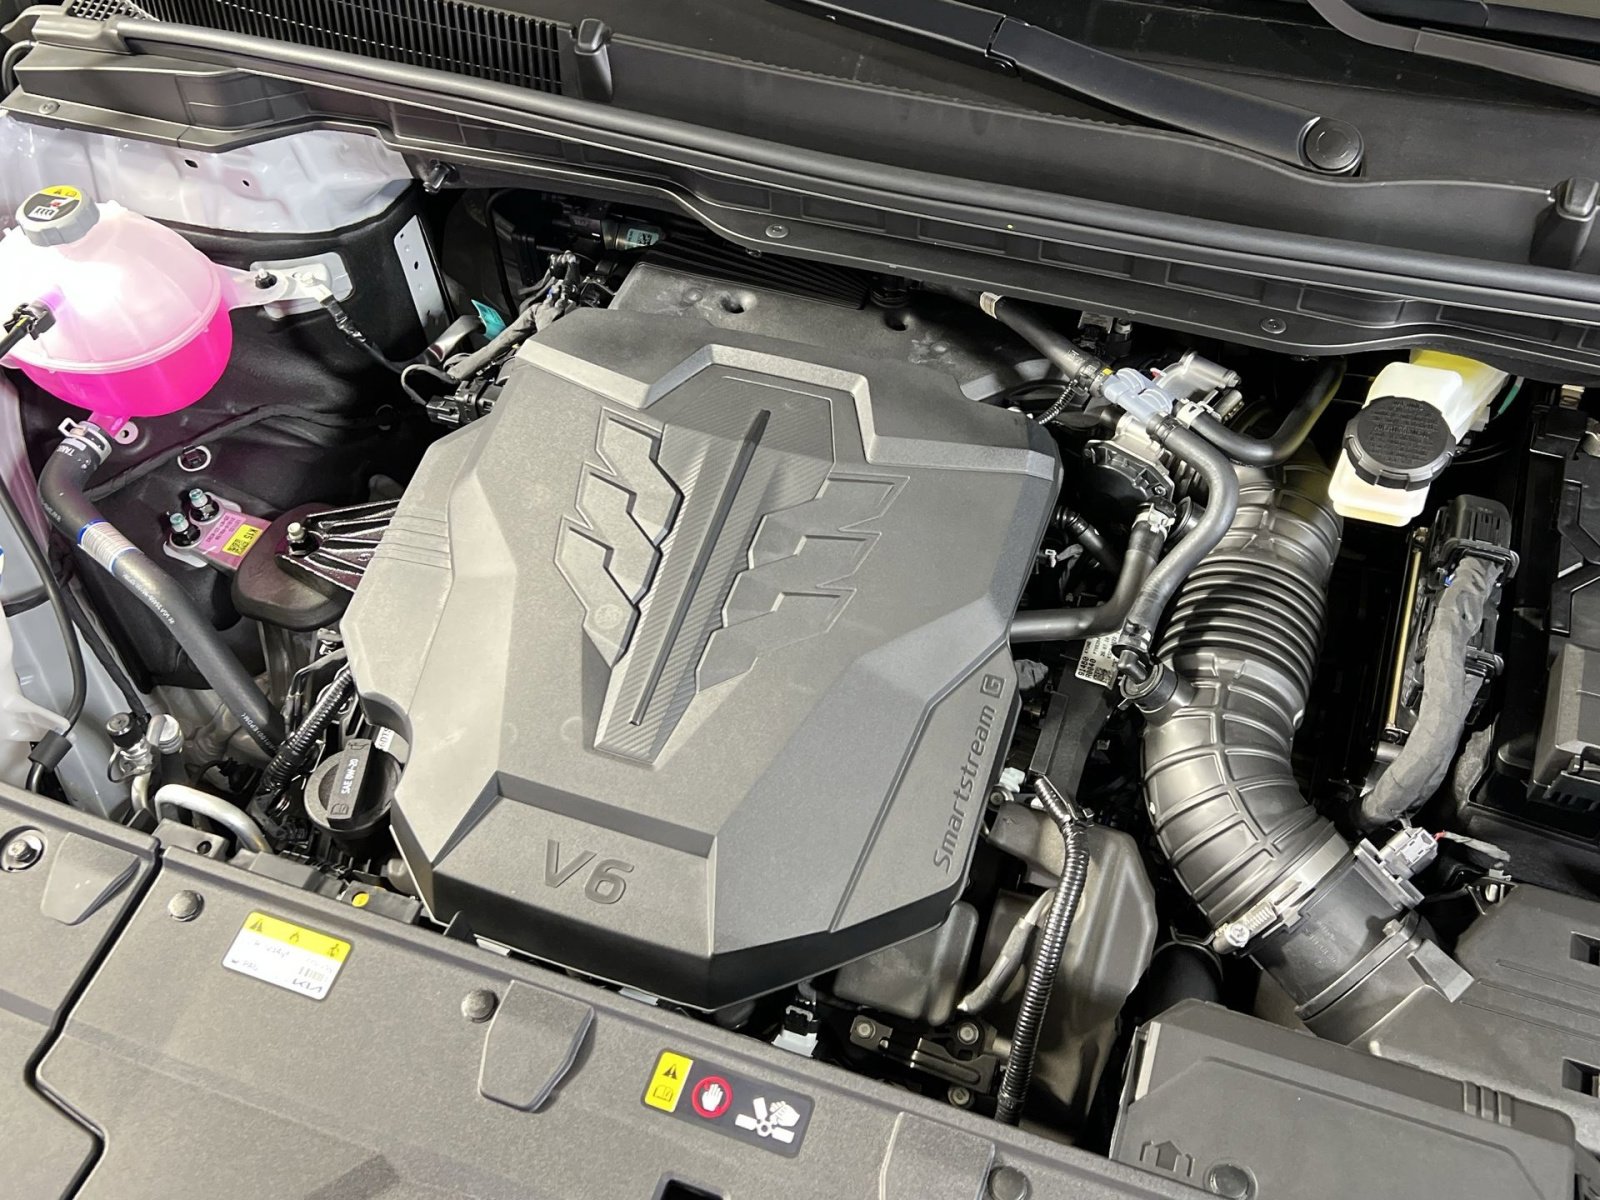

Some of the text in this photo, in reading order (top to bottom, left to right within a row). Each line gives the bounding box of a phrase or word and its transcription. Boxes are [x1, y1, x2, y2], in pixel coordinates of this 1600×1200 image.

[341, 758, 359, 794] SAE 0W-20
[933, 704, 996, 874] Smartstream
[545, 839, 635, 905] V6
